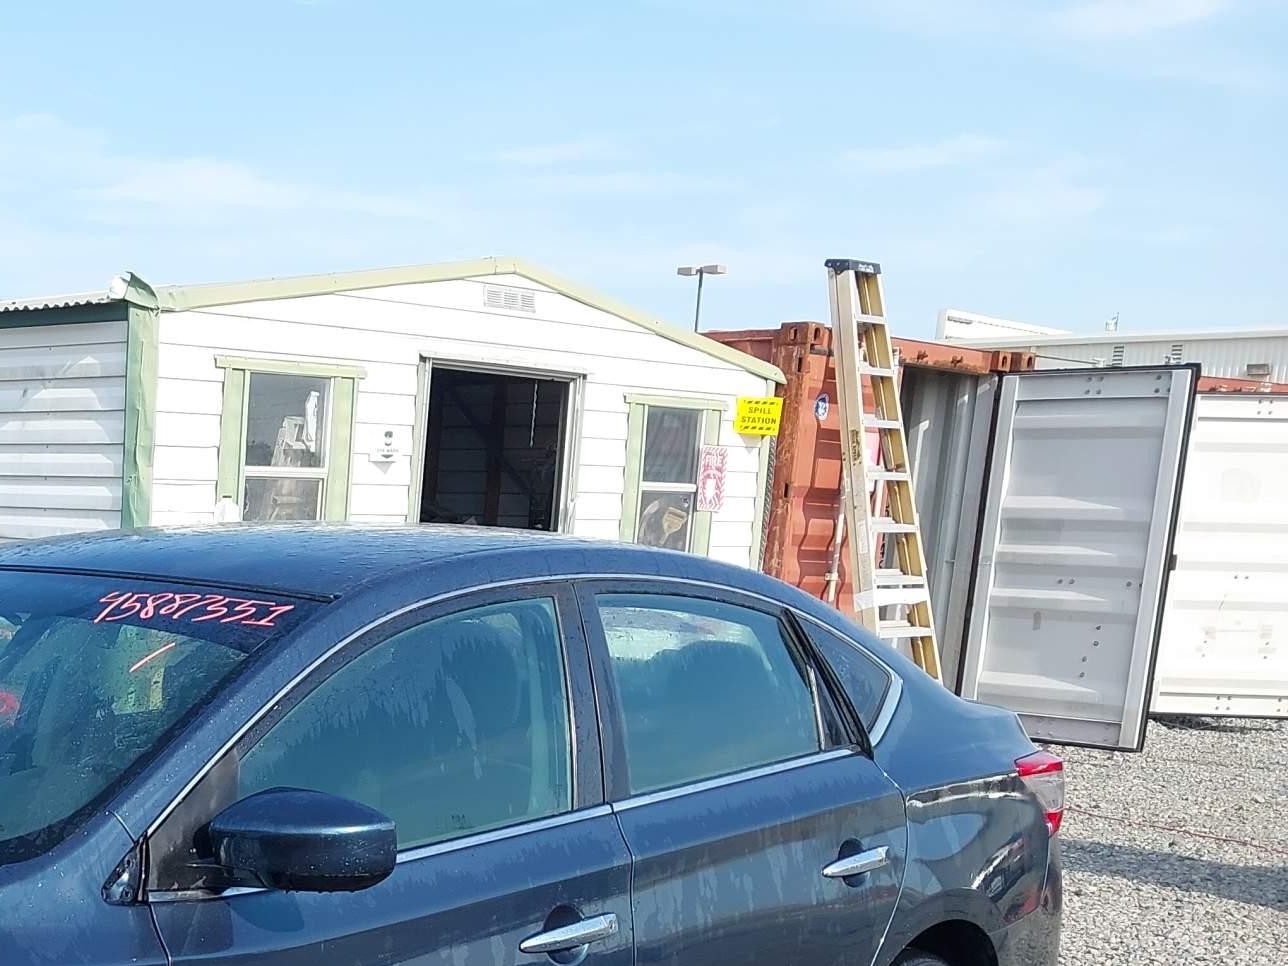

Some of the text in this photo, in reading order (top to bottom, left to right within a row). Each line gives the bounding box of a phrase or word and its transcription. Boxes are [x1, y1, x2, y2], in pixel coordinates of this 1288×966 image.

[747, 406, 772, 415] SPILL
[740, 415, 777, 425] STATION
[94, 591, 294, 626] 45887551
